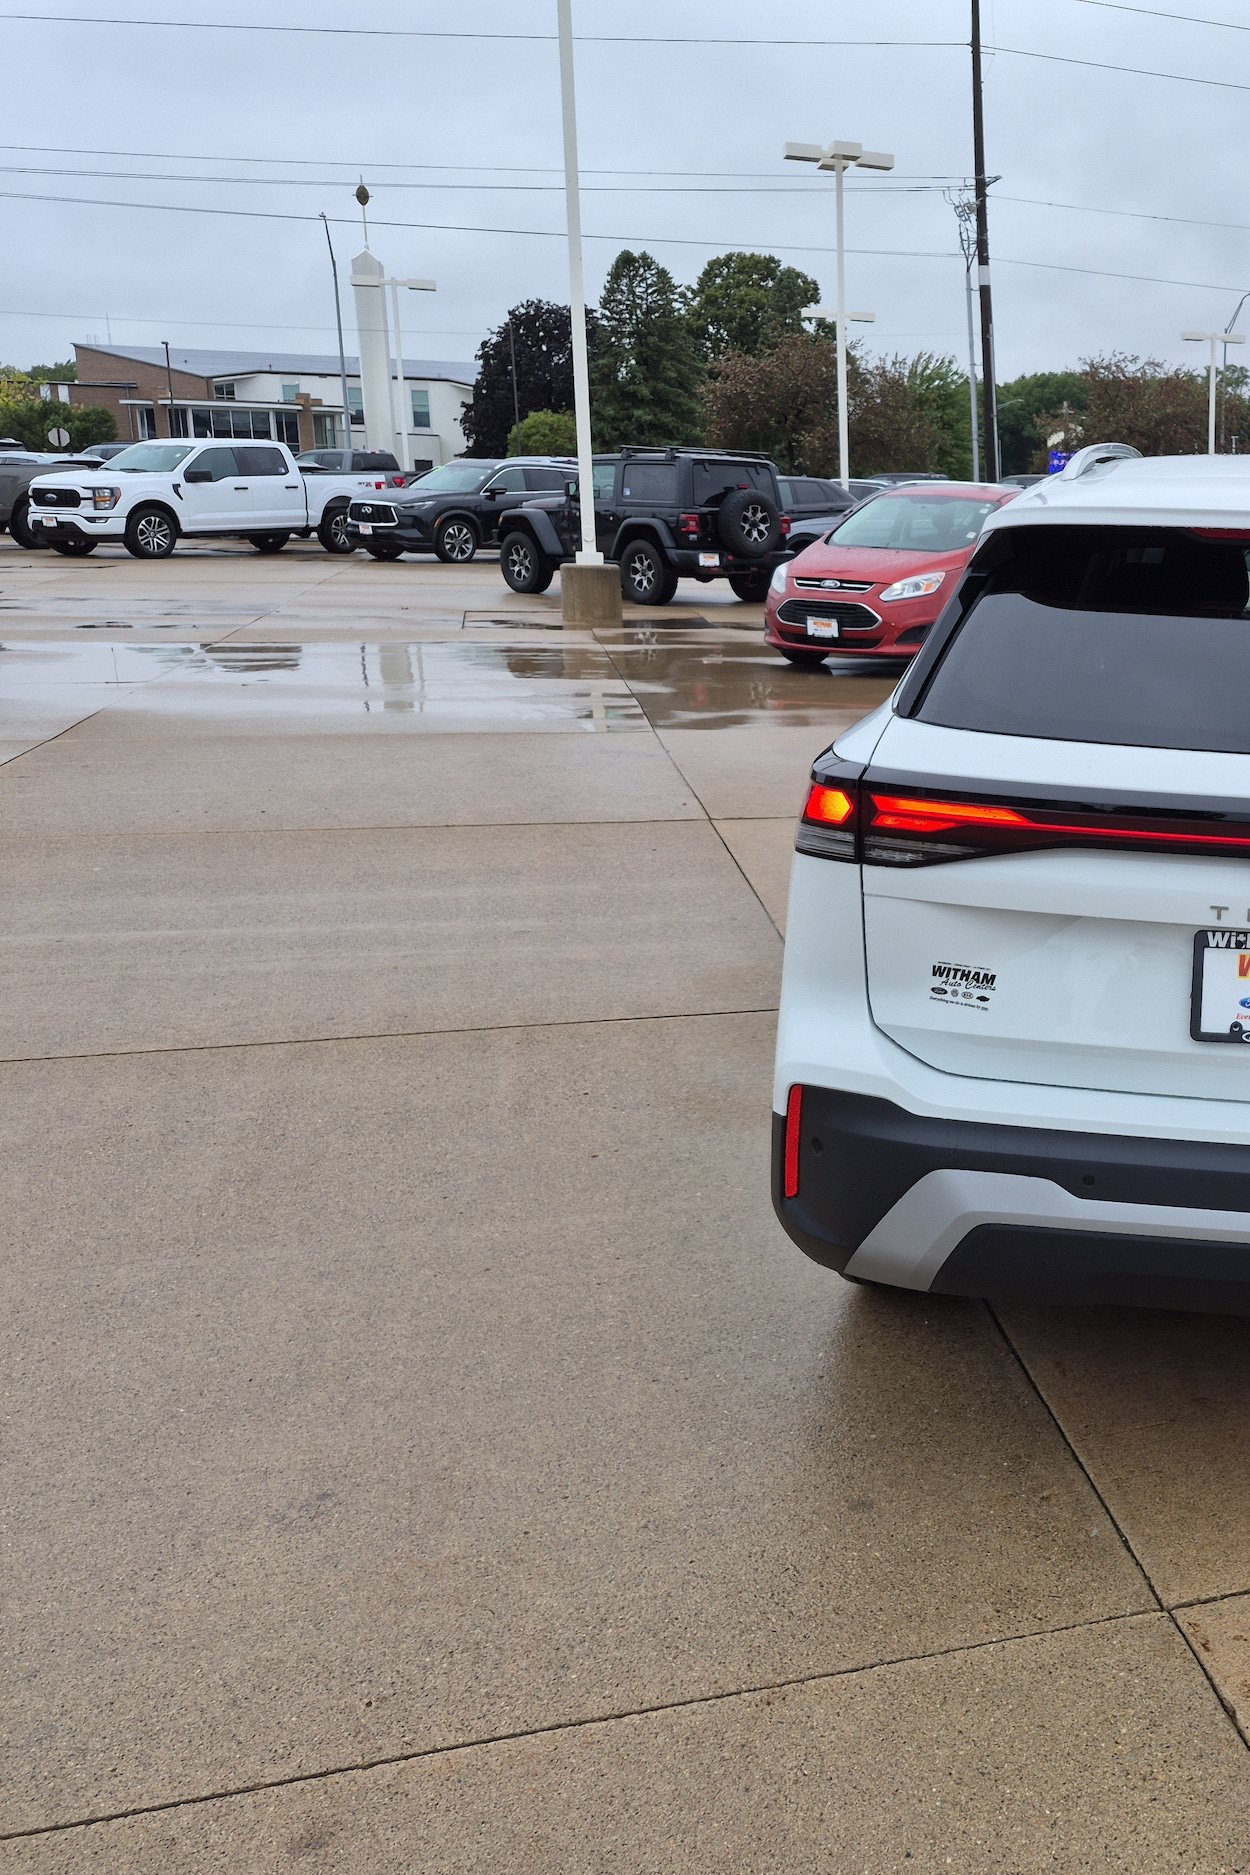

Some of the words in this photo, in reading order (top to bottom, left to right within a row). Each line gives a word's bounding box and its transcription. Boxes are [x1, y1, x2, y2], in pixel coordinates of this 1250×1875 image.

[932, 964, 997, 986] WITHAM
[940, 978, 962, 988] Auto
[965, 980, 997, 991] Centers
